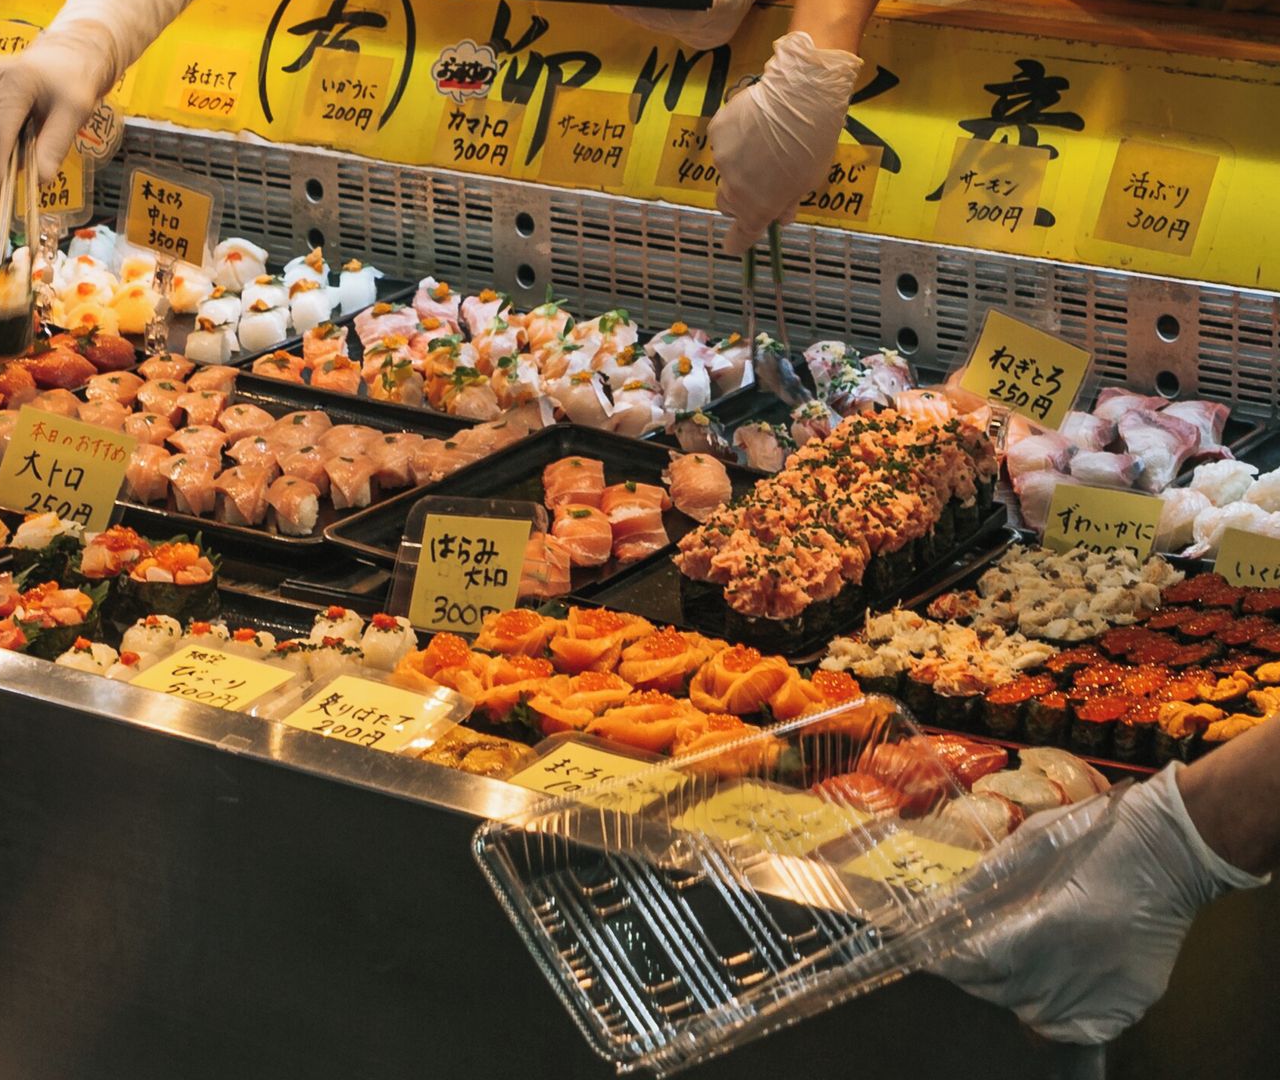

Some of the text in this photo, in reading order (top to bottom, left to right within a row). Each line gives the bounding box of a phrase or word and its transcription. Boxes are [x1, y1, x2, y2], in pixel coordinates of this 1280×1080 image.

[181, 61, 238, 91] 活ほたて
[436, 56, 498, 84] おすすめ
[321, 76, 379, 100] いかうに
[187, 92, 236, 115] 400円
[322, 103, 374, 132] 200円
[447, 108, 509, 139] カマトロ
[557, 115, 626, 140] サーモントロ
[453, 138, 509, 167] 300円
[572, 142, 624, 168] 400円
[140, 180, 184, 209] 本まぐろ
[959, 170, 1018, 196] サーモン
[1123, 172, 1190, 208] 活ぶり
[38, 189, 70, 209] 50円
[800, 190, 864, 216] 200円
[147, 206, 181, 230] 中トロ
[965, 201, 1024, 233] 300円
[1127, 207, 1191, 241] 300円
[147, 229, 190, 257] 350円
[989, 346, 1065, 396] ねぎとろ
[989, 379, 1054, 420] 250円
[30, 421, 127, 464] 本日のおすすめ
[15, 450, 85, 491] 大トロ
[431, 533, 499, 565] はらみ
[464, 567, 508, 590] 大トロ
[171, 664, 248, 690] びっくり
[166, 681, 239, 710] 500円
[320, 718, 386, 747] 200円
